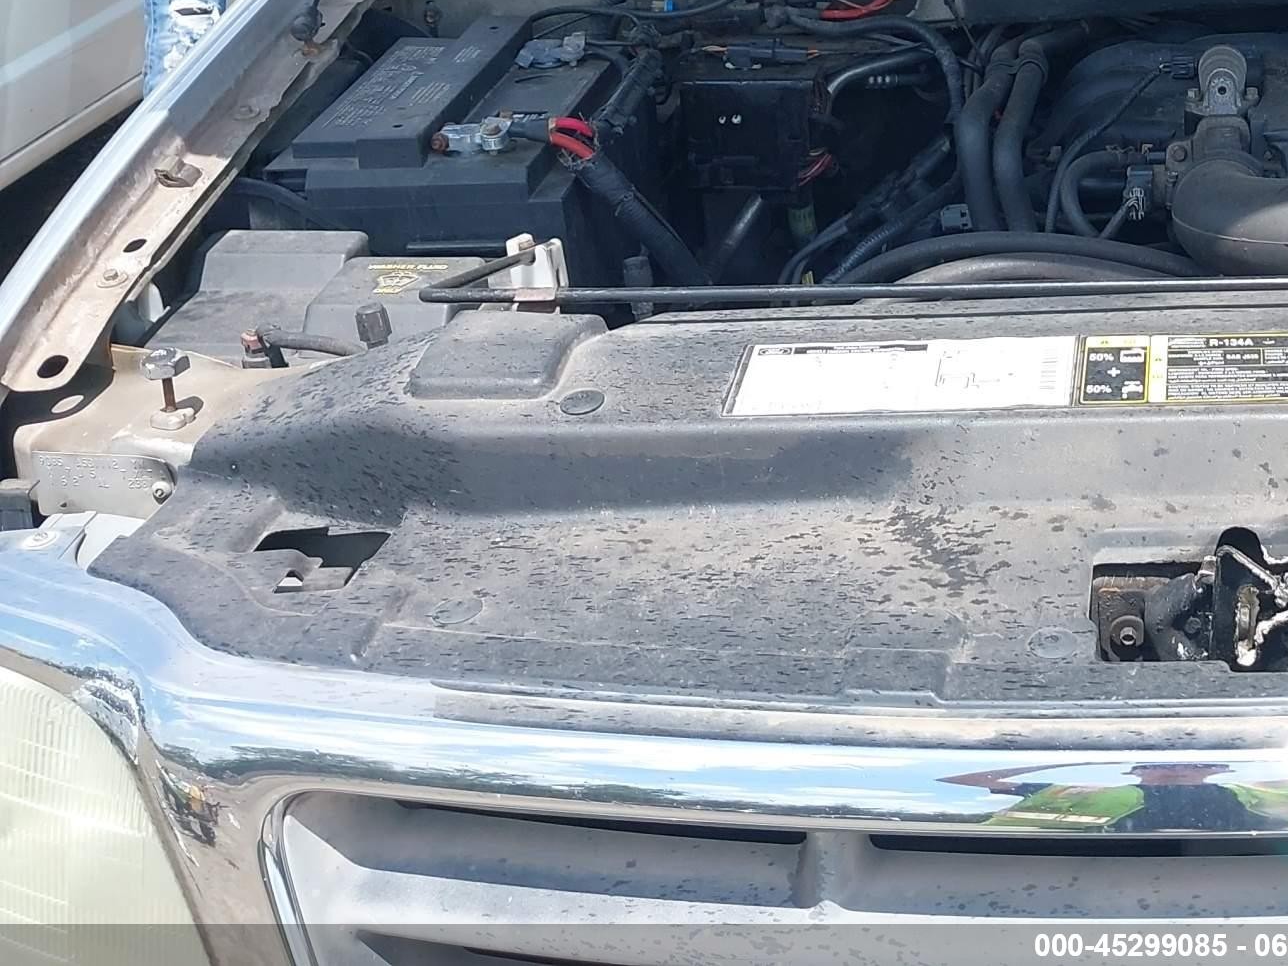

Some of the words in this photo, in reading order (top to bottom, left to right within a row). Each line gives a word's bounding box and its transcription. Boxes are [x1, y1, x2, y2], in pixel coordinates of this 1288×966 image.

[1209, 337, 1254, 347] R-134A
[1089, 352, 1115, 362] 50%
[1086, 384, 1112, 394] 50%
